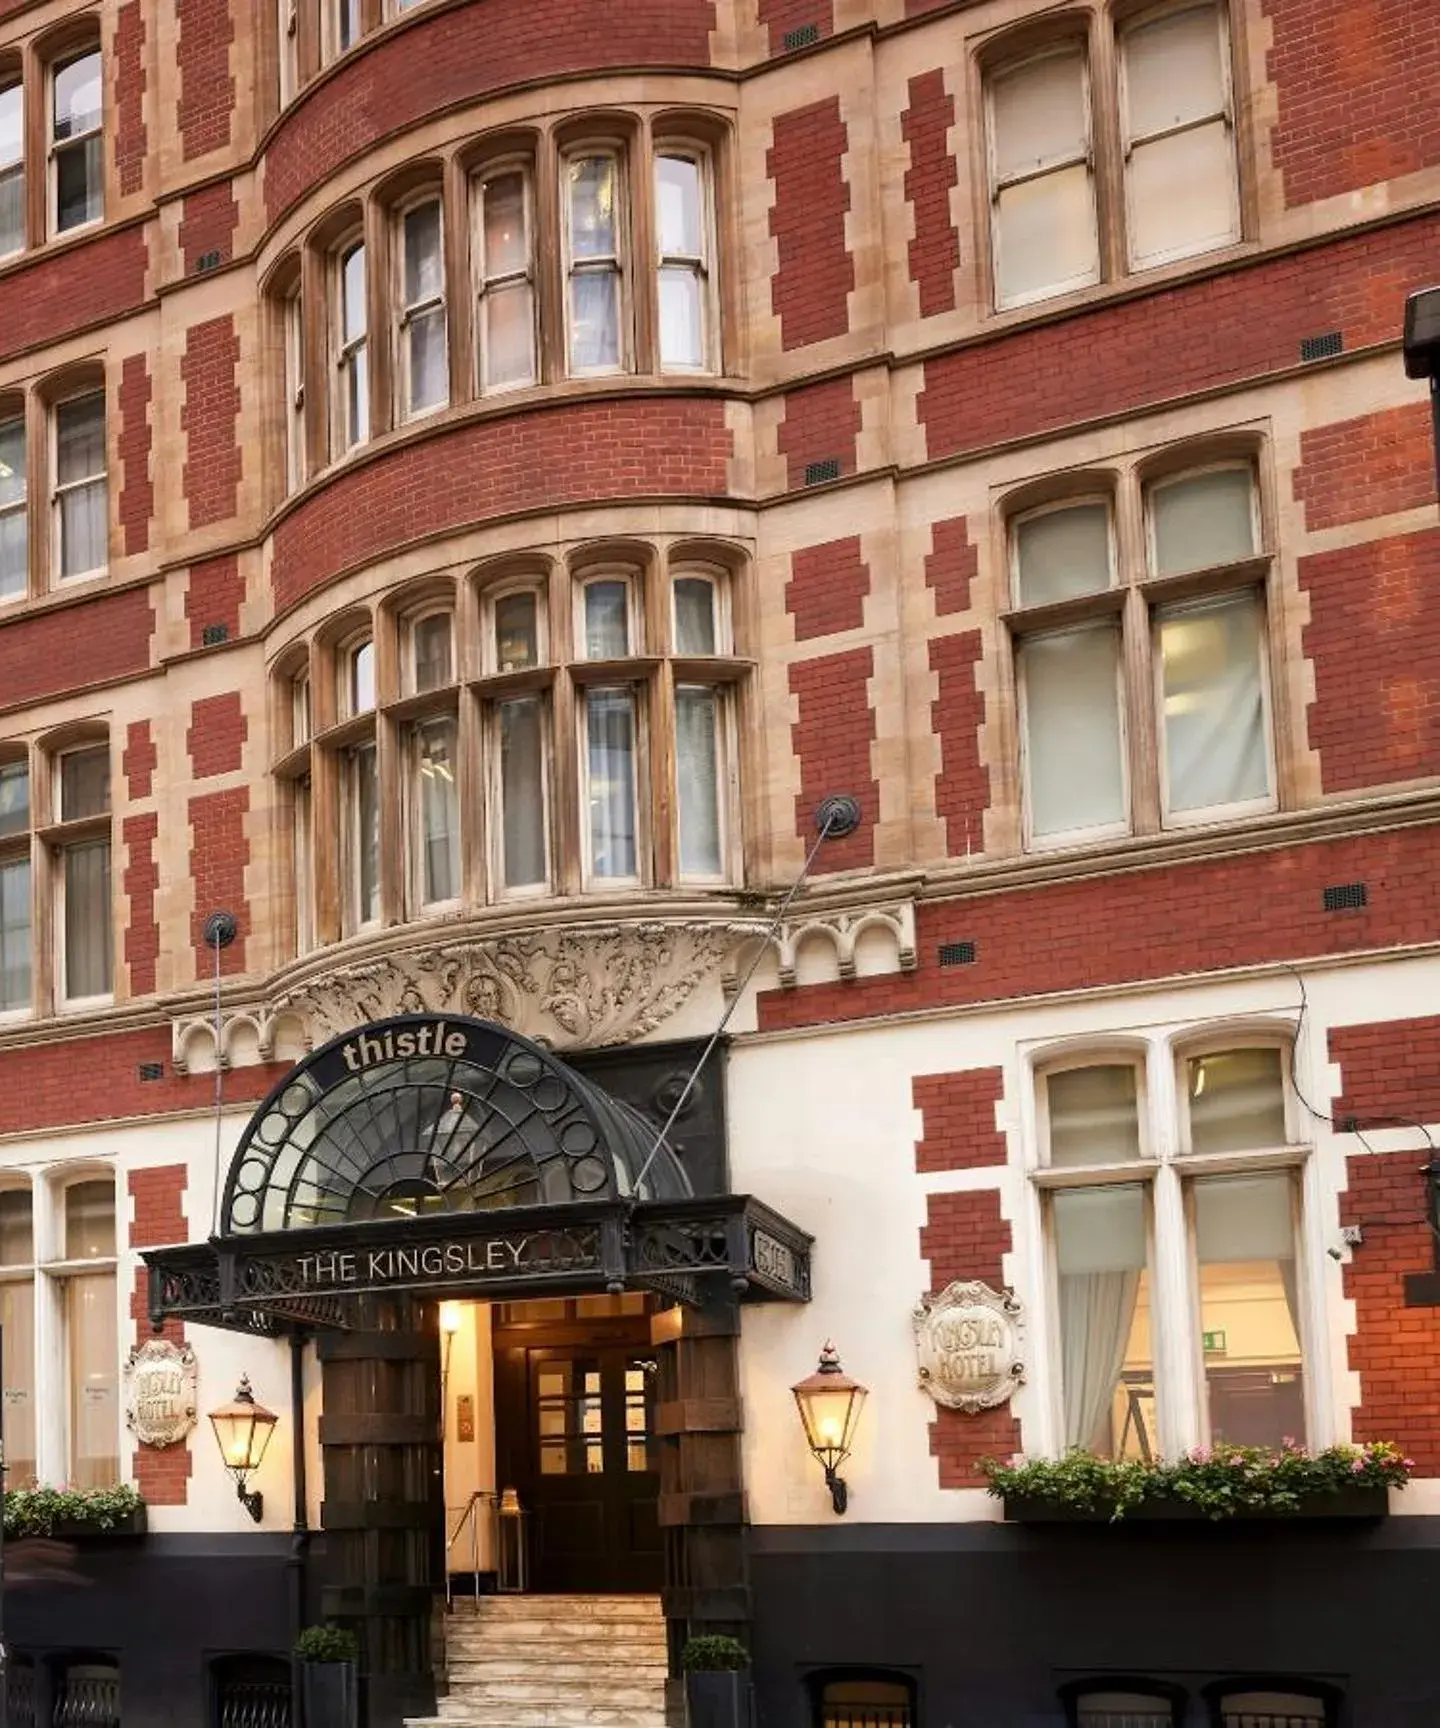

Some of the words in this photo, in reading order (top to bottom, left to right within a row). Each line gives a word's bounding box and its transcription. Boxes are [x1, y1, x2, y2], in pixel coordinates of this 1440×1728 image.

[342, 1021, 468, 1071] thistle
[296, 1252, 357, 1284] THE
[368, 1239, 528, 1280] KINGSLEY
